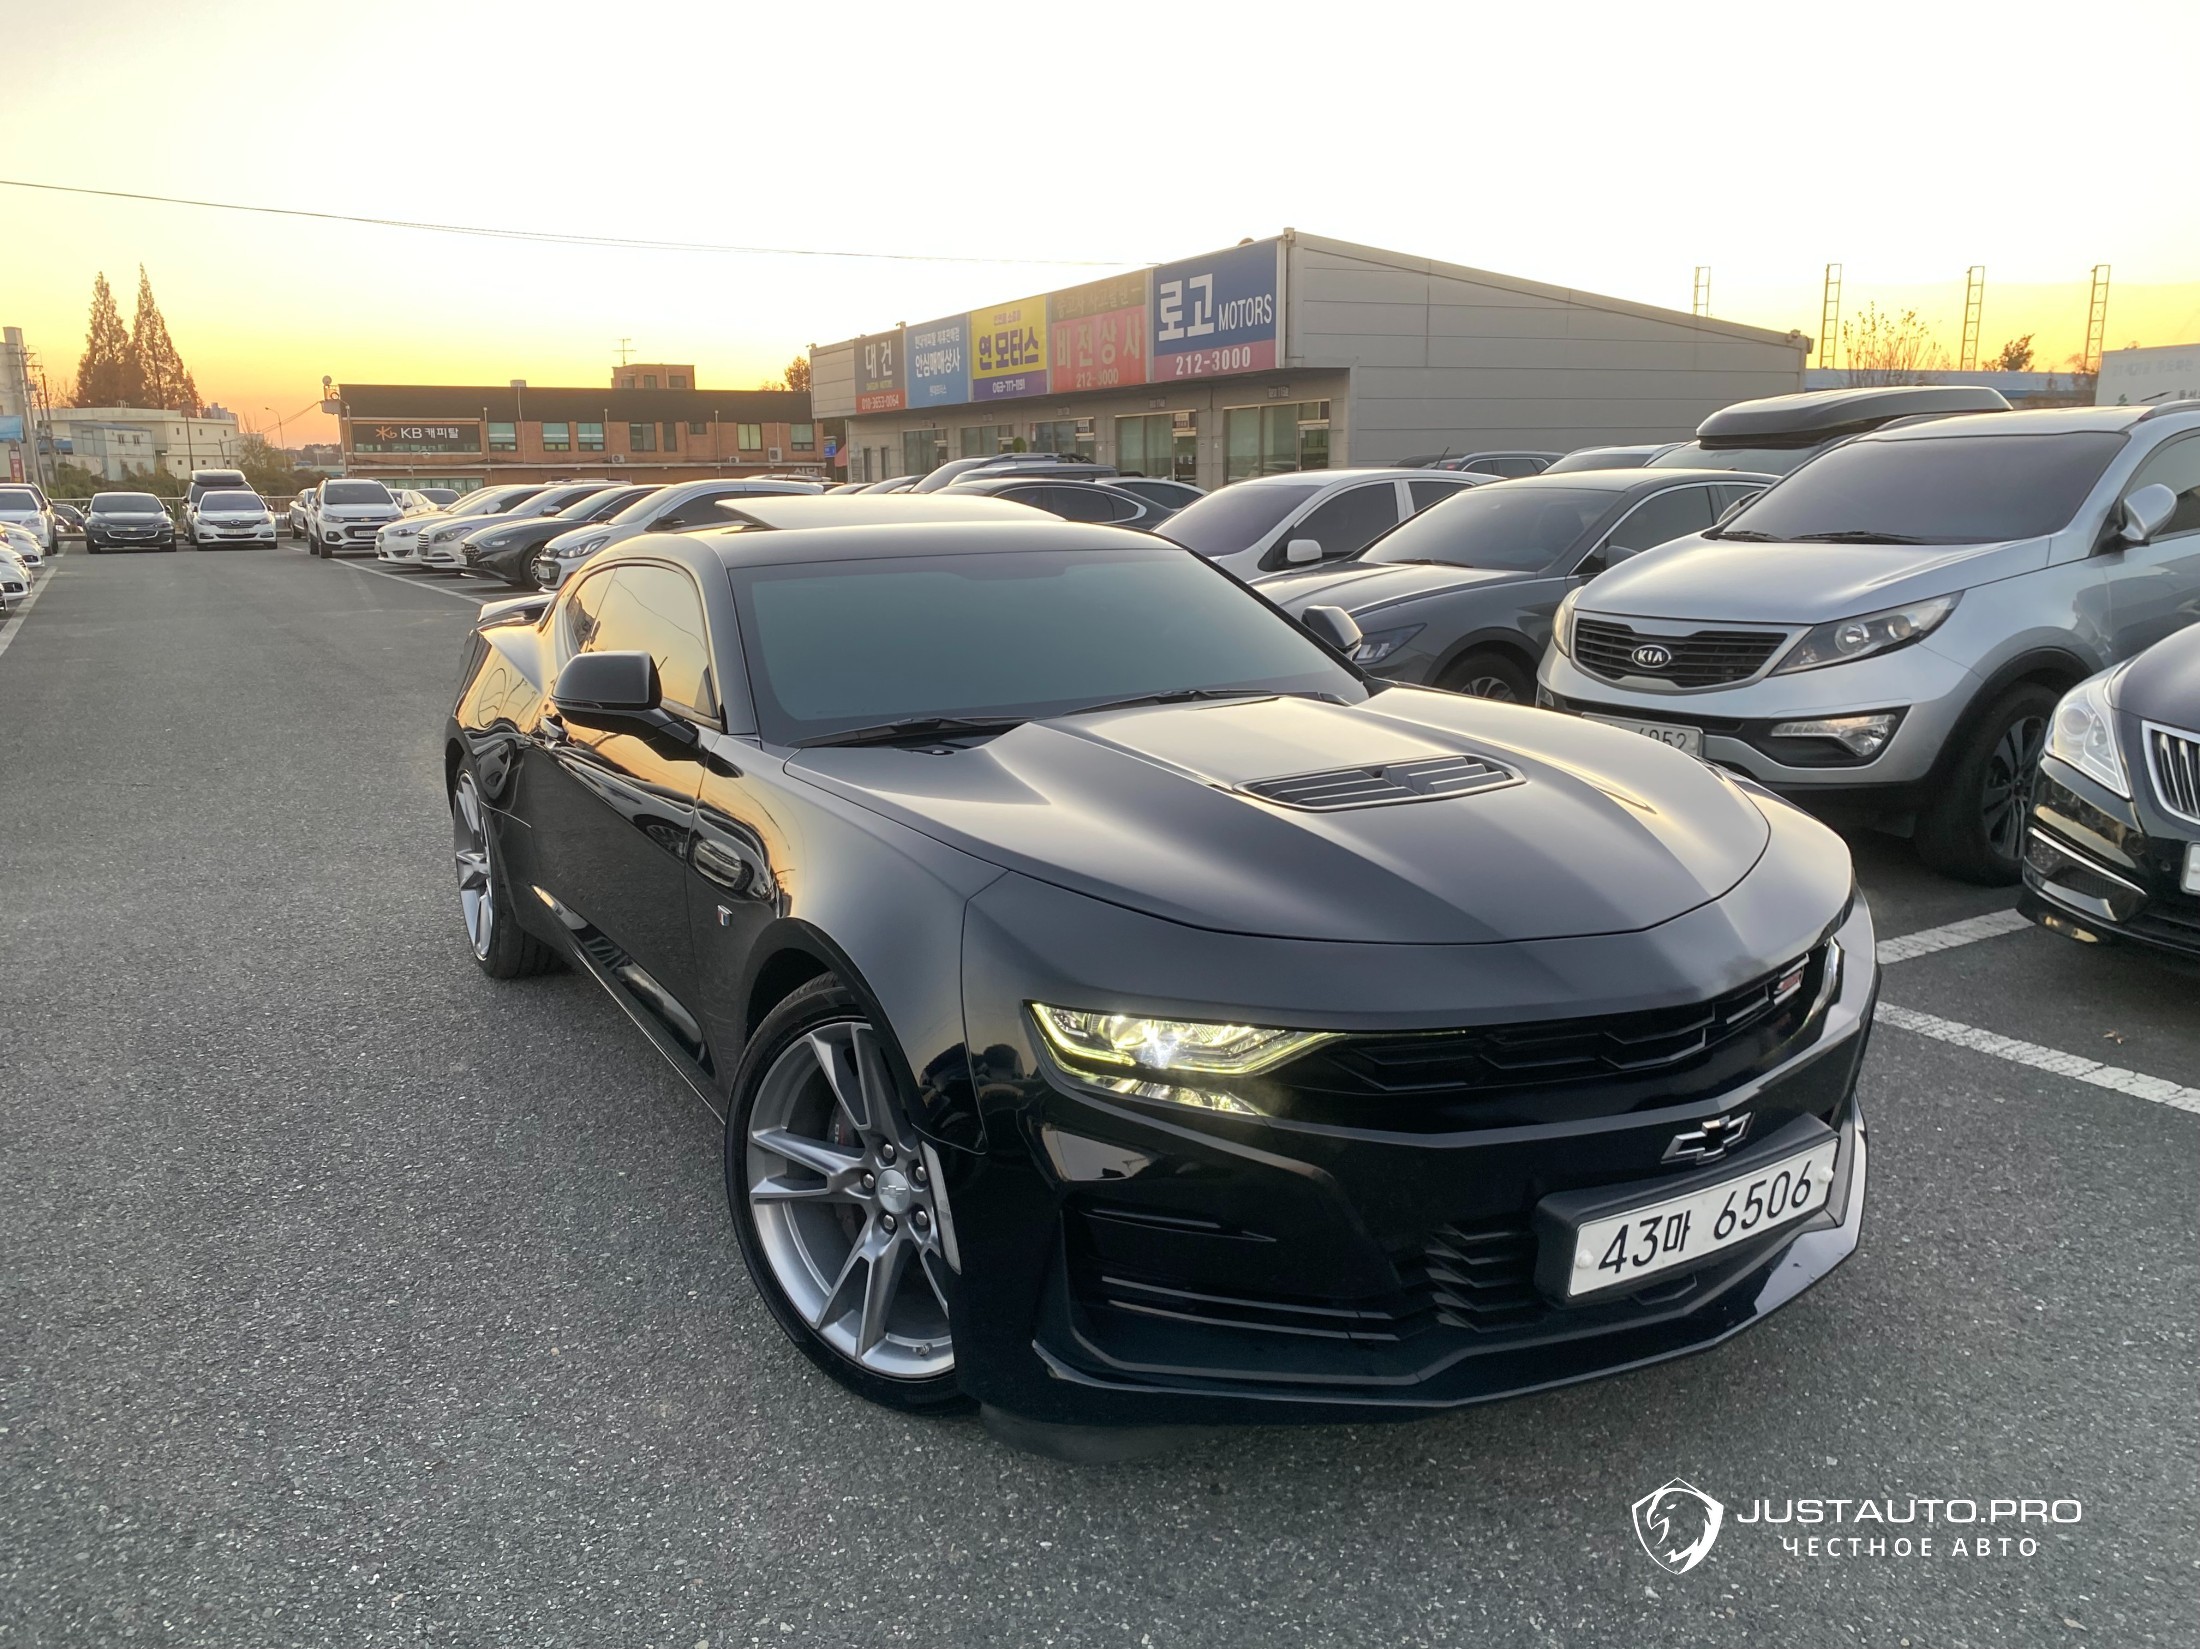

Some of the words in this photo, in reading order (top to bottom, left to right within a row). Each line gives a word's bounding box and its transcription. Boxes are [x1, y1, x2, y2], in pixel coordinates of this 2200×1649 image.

[1158, 273, 1215, 342] 로고
[1218, 293, 1272, 331] MOTORS
[915, 347, 961, 378] 안심매매상사
[979, 334, 993, 371] 연
[995, 326, 1039, 369] 모터스
[1175, 346, 1251, 376] 212-3000
[1076, 368, 1119, 388] 212-3000
[400, 427, 422, 439] KB
[425, 427, 459, 439] 캐피탈
[1637, 649, 1663, 663] KIA
[1597, 1210, 1691, 1274] 43마
[1713, 1160, 1812, 1240] 6506
